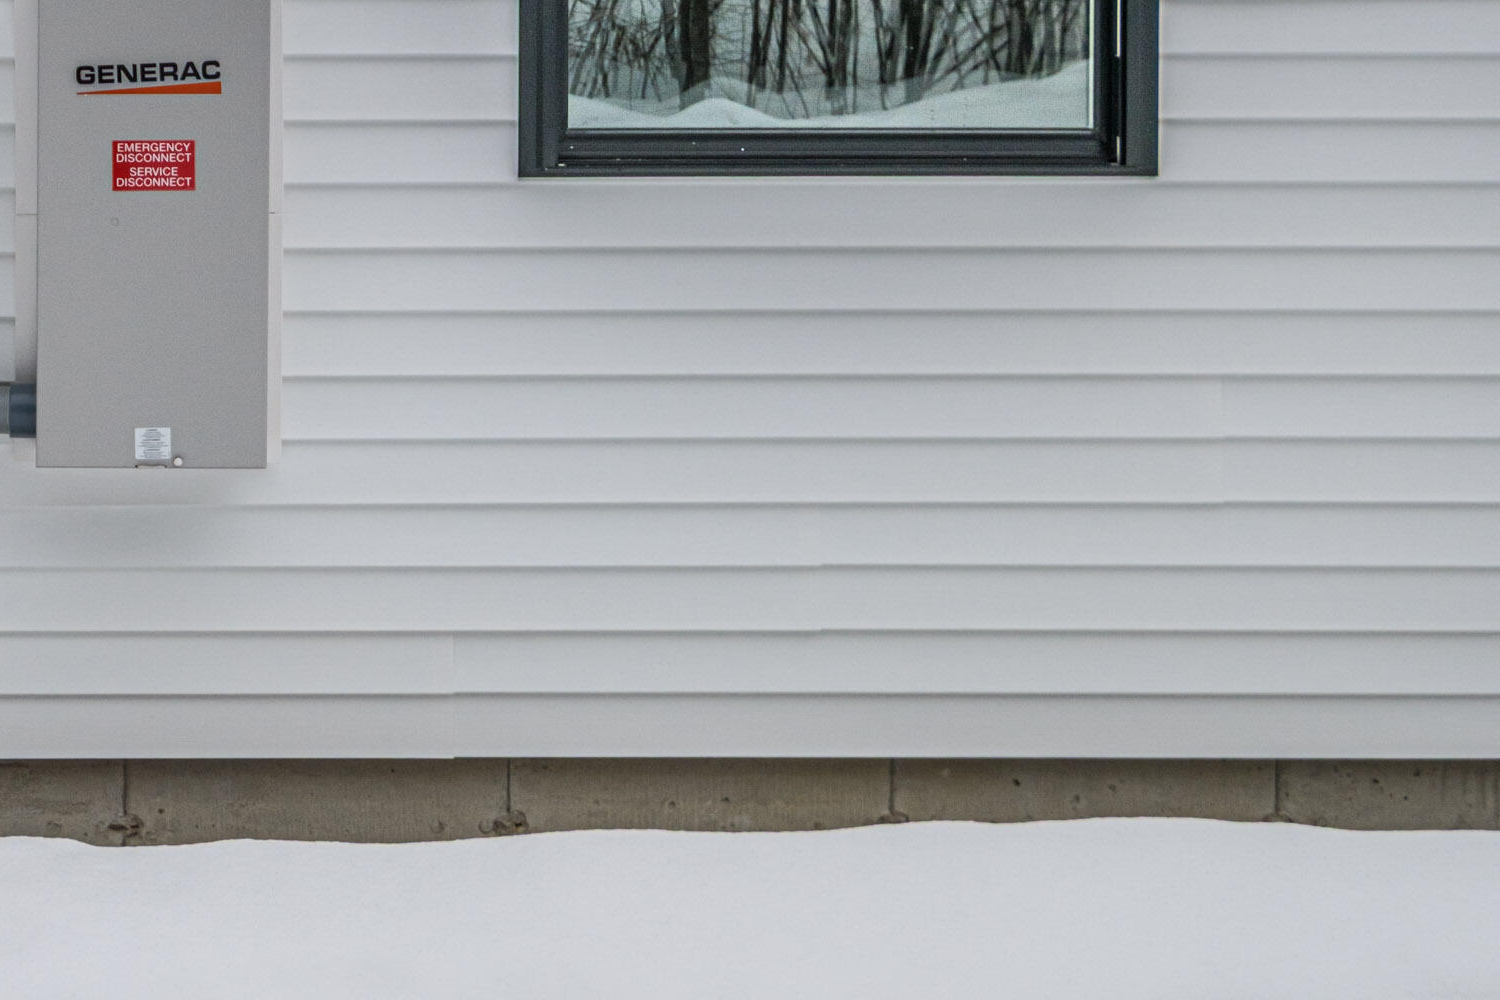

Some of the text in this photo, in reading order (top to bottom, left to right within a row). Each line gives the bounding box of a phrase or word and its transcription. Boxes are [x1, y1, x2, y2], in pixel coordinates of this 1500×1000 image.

[76, 60, 221, 85] GENERAC
[116, 142, 191, 153] EMERGENCY
[115, 152, 192, 163] DISCONNECT
[129, 166, 179, 177] SERVICE
[115, 177, 192, 188] DISCONNECT
